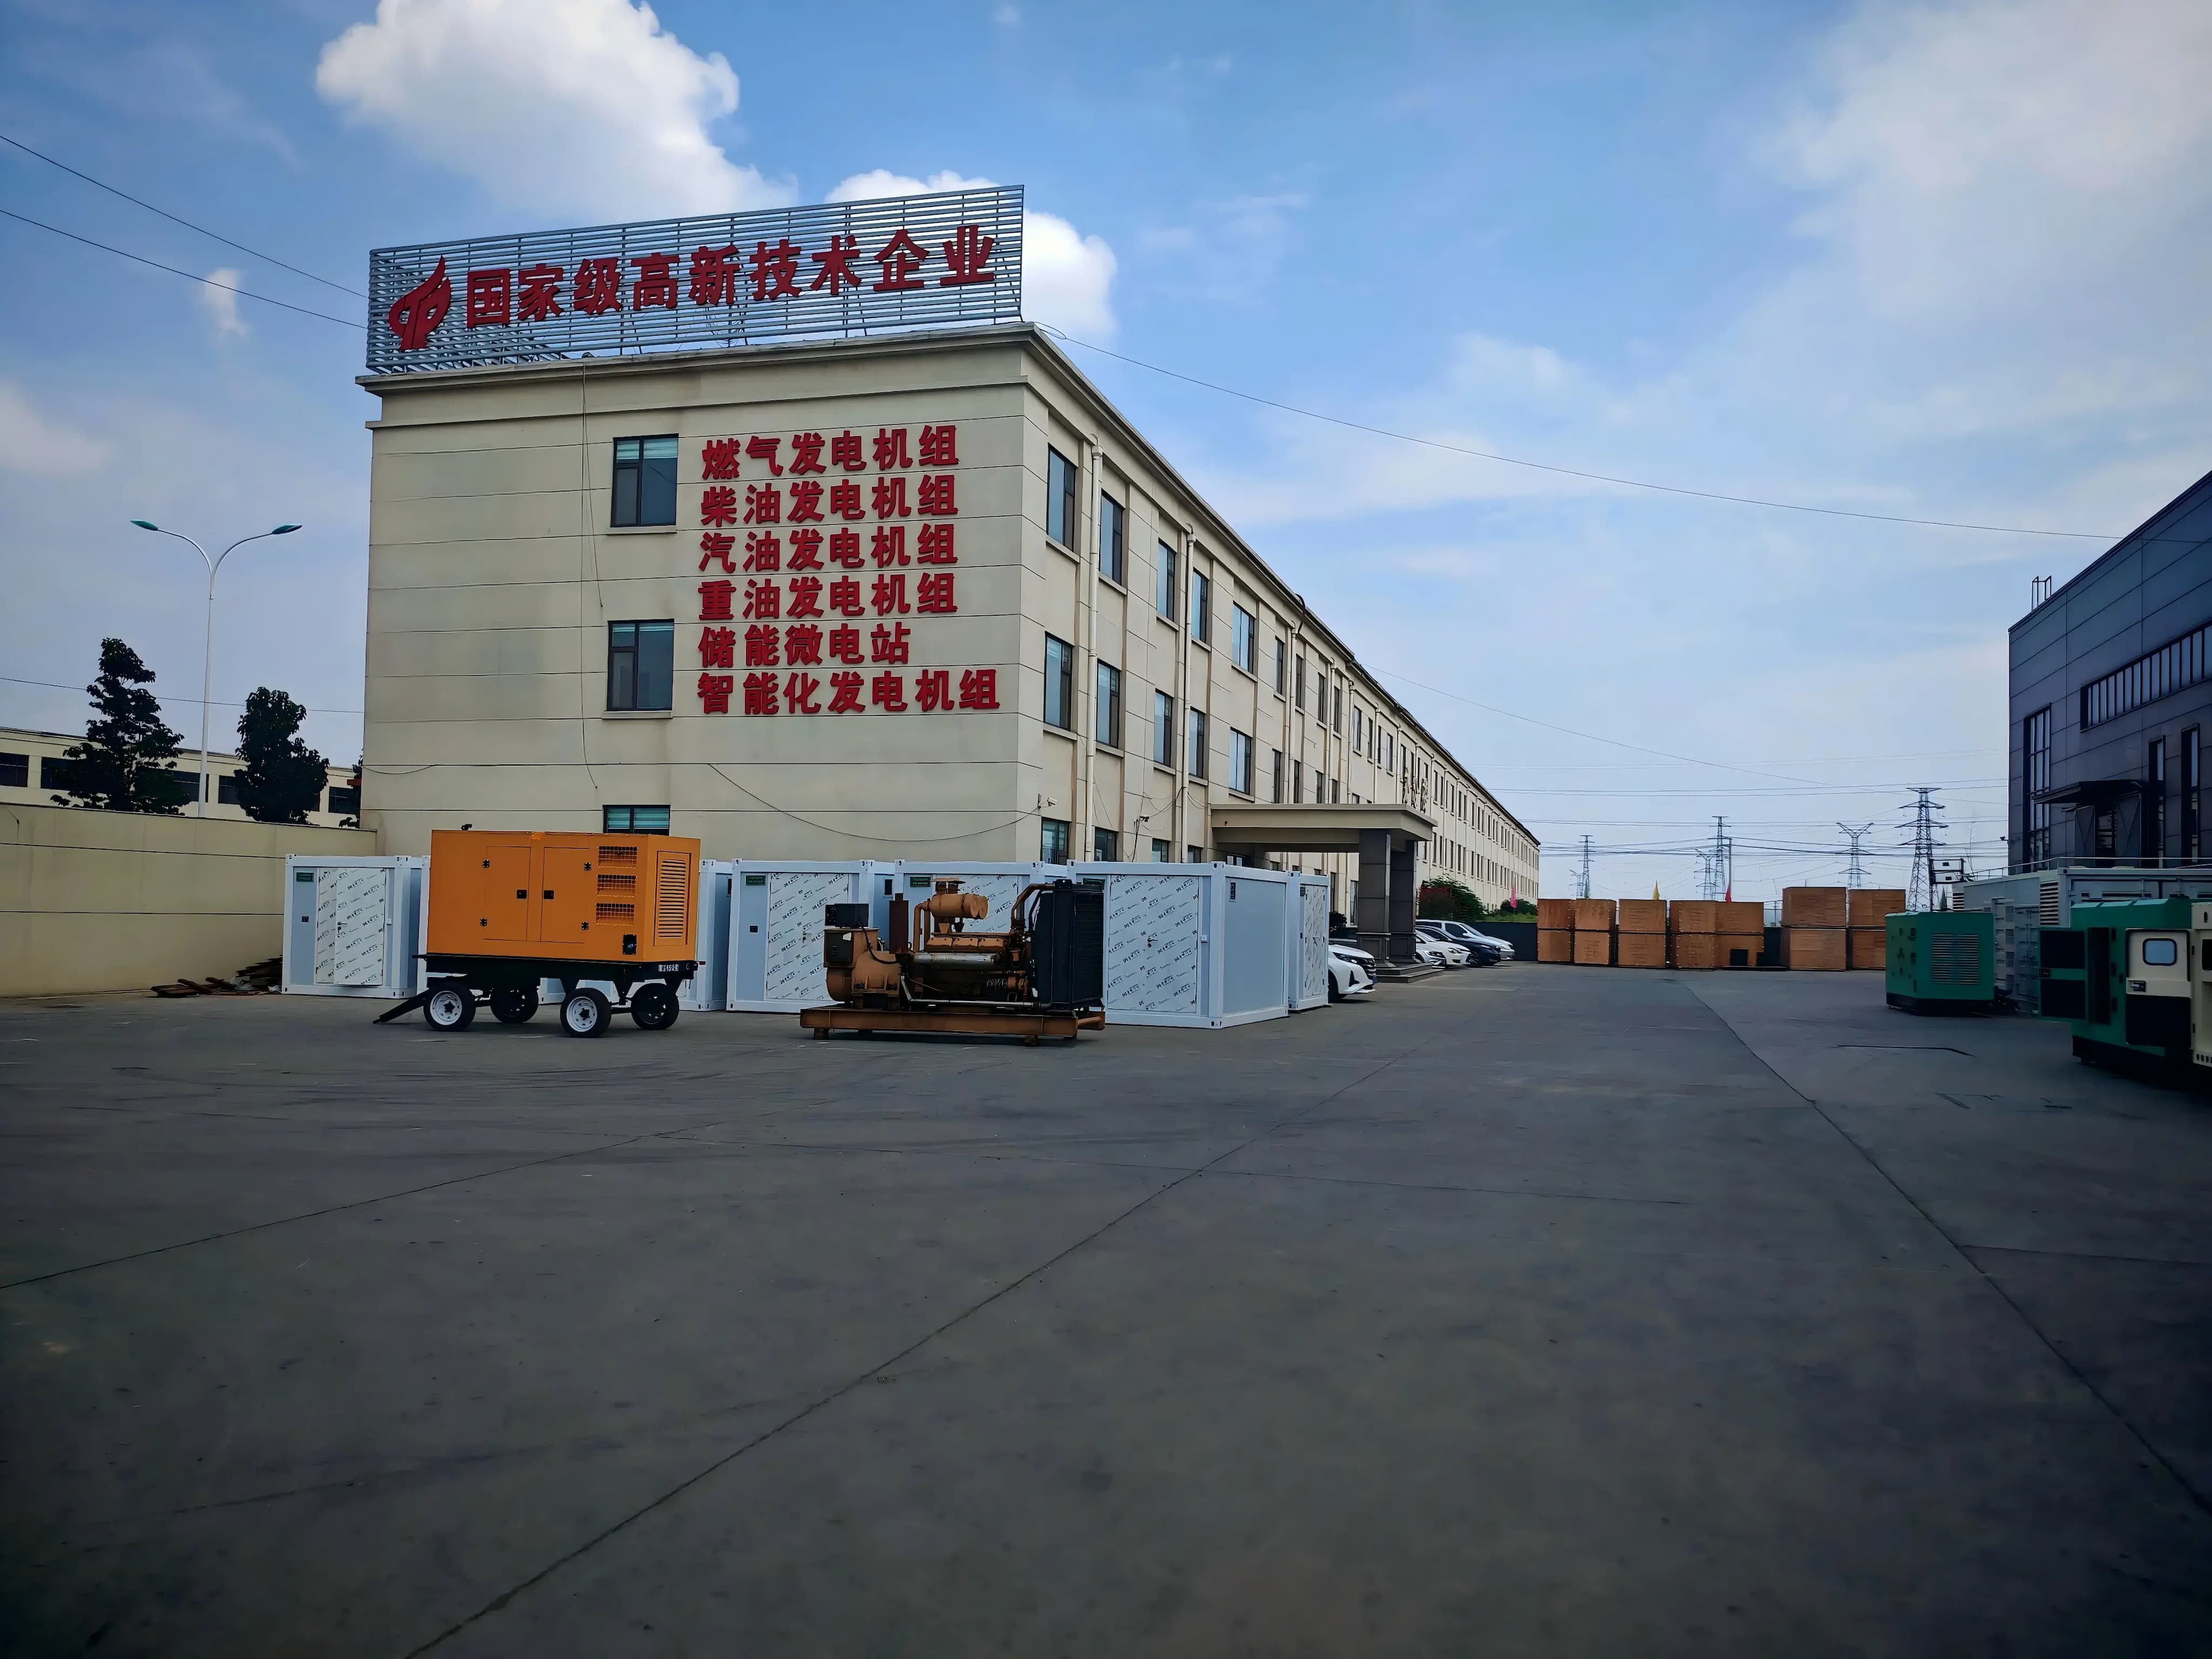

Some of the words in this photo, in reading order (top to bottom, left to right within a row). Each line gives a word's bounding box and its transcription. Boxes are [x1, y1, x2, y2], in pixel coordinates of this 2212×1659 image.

[467, 225, 994, 328] 国家级高新技术企业
[702, 425, 959, 479] 燃气发电机组
[700, 475, 958, 527] 柴油发电机组
[699, 523, 957, 573] 汽油发电机组
[698, 573, 957, 620] 重油发电机组
[698, 622, 911, 668] 储能微电站
[697, 669, 1000, 714] 智能化发电机组
